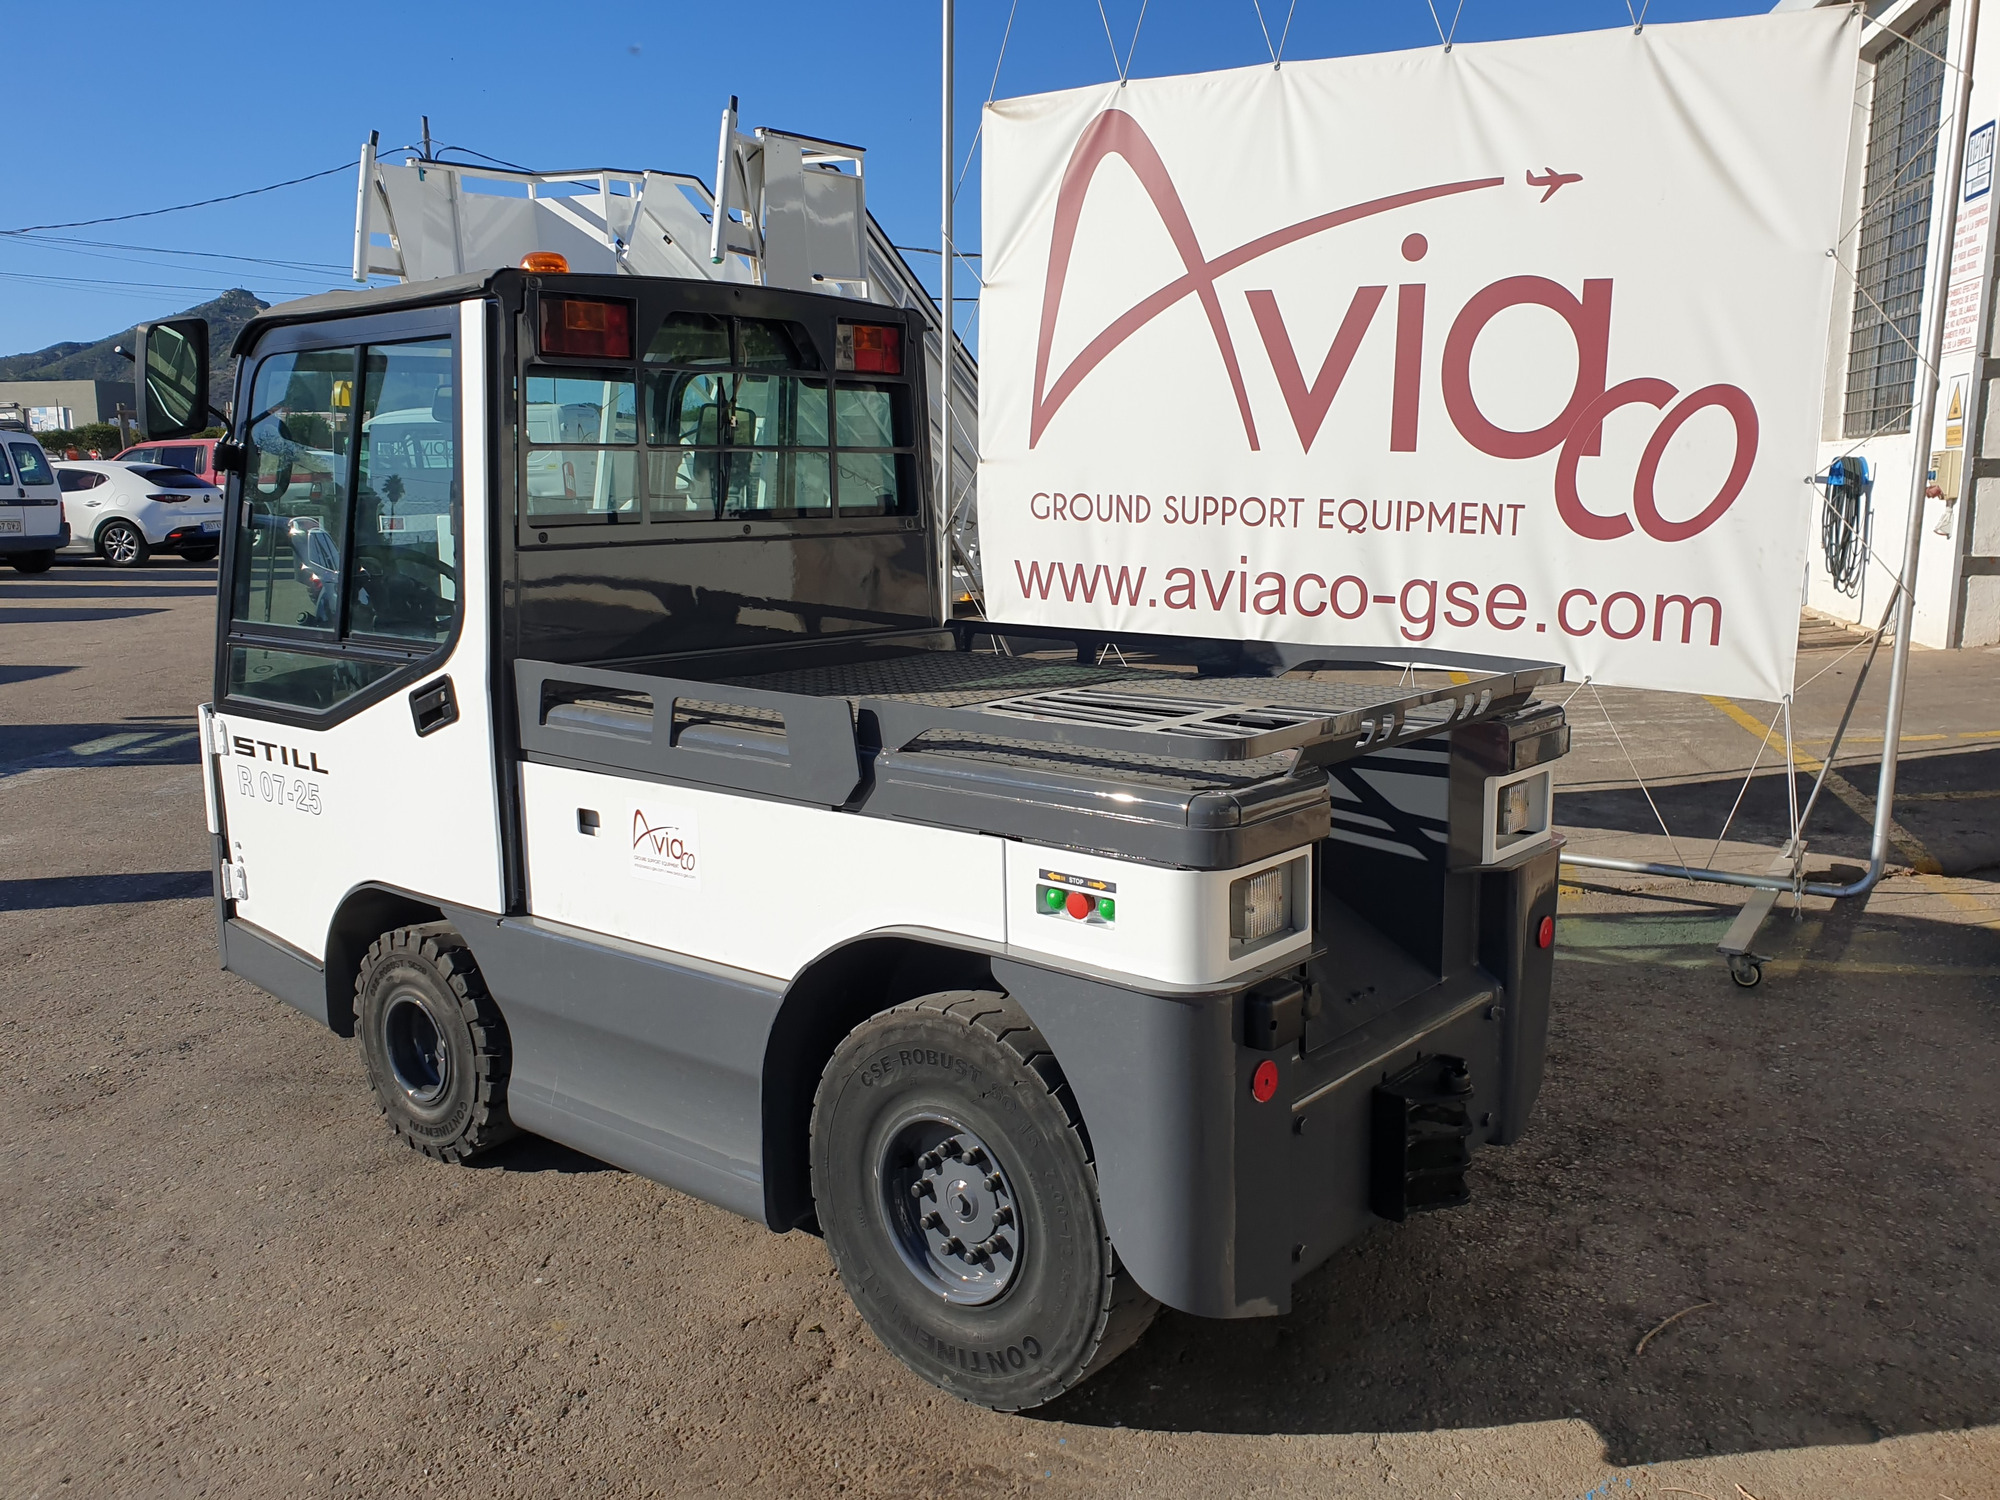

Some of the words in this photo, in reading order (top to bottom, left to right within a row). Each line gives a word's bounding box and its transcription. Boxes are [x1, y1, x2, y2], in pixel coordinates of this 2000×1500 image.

[1029, 108, 1760, 543] Aviaco
[1030, 492, 1151, 524] GROUND
[1164, 495, 1305, 528] SUPPORT
[1318, 499, 1527, 536] EQUIPMENT
[1013, 555, 1723, 647] www.aviaco-gse.com
[232, 735, 329, 775] STILL
[236, 764, 255, 798] R
[259, 770, 323, 816] 07-25
[632, 808, 696, 871] Aviaco
[1068, 876, 1084, 885] STOP
[860, 1048, 984, 1088] CSE-ROBUST
